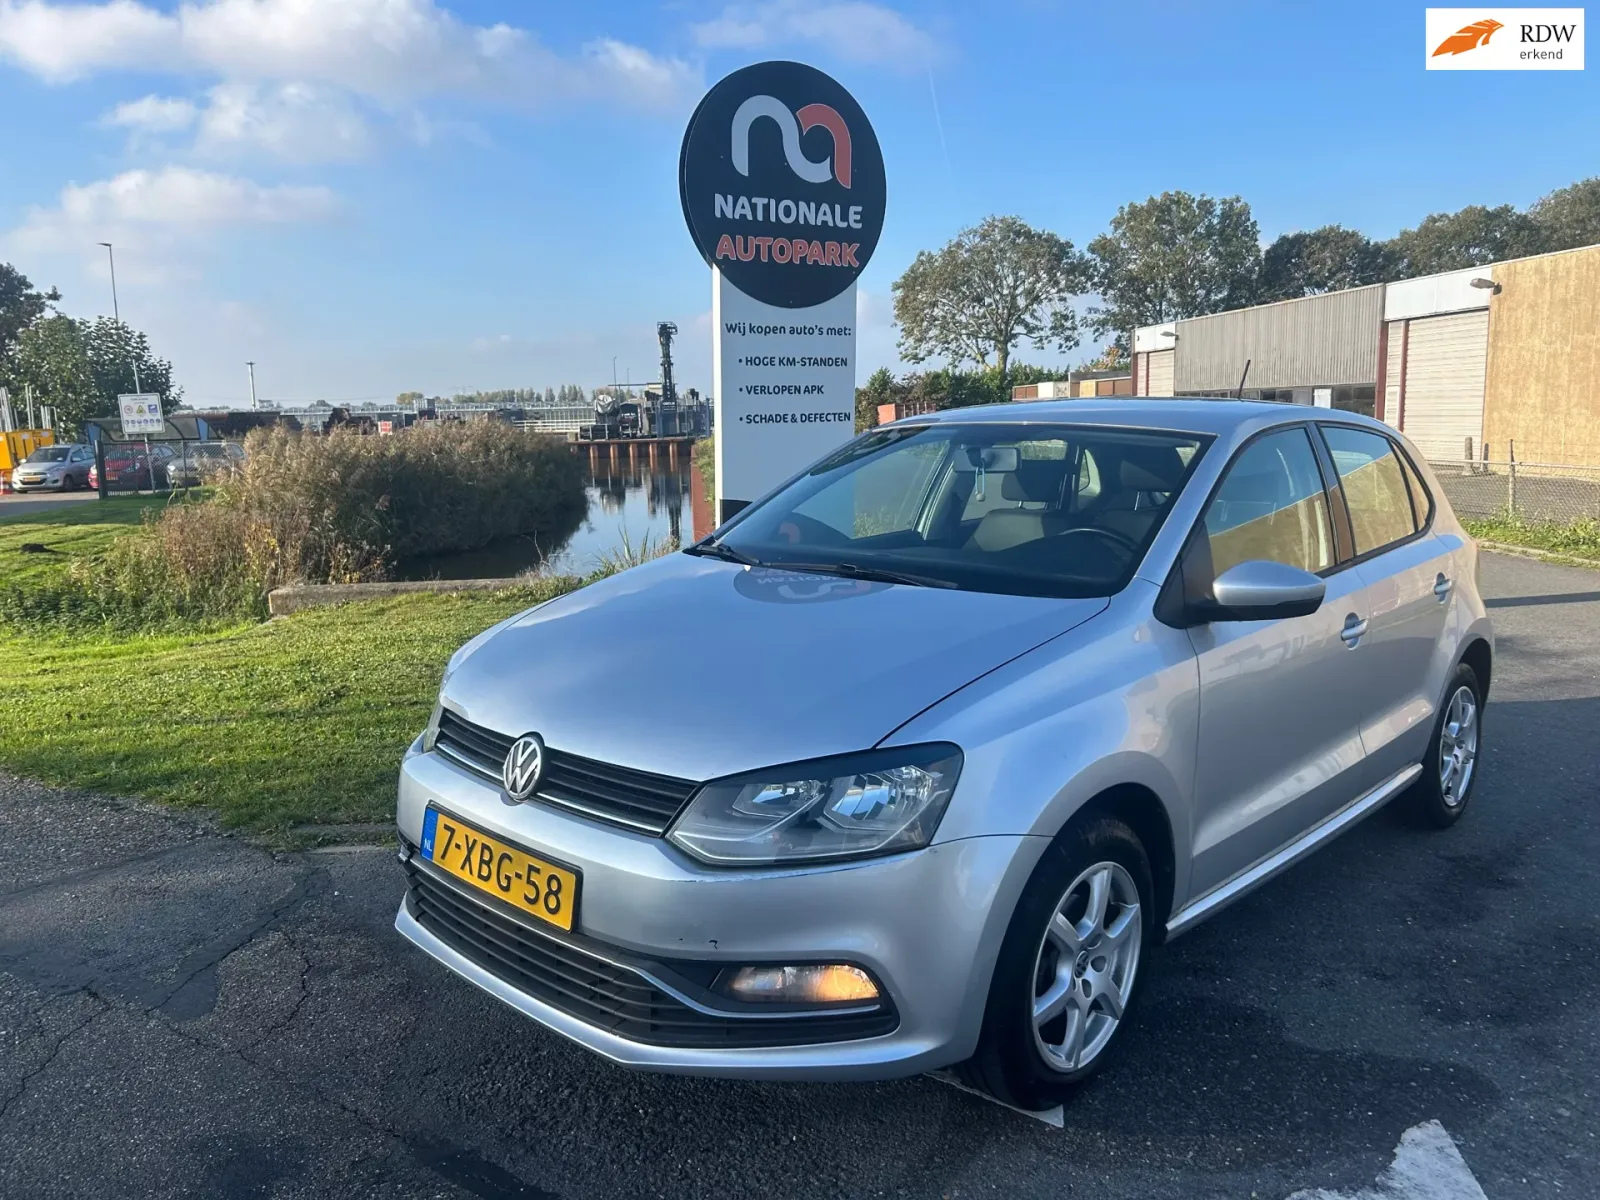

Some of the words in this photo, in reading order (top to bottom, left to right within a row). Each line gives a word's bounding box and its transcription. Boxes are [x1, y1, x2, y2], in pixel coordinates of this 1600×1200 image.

[714, 193, 863, 229] NATIONALE
[715, 234, 861, 268] AUTOPARK
[725, 322, 746, 336] Wij
[749, 323, 786, 336] kopen
[789, 325, 824, 336] auto's
[826, 326, 852, 336] met:
[745, 356, 776, 366] HOGE
[778, 357, 848, 367] KM-STANDEN
[745, 385, 801, 395] VERLOPEN
[803, 385, 825, 395] APK
[746, 413, 789, 424] SCHADE
[790, 413, 798, 423] &
[800, 412, 851, 423] DEFECTEN
[423, 837, 433, 852] NL
[440, 823, 563, 915] 7-XBG-58
